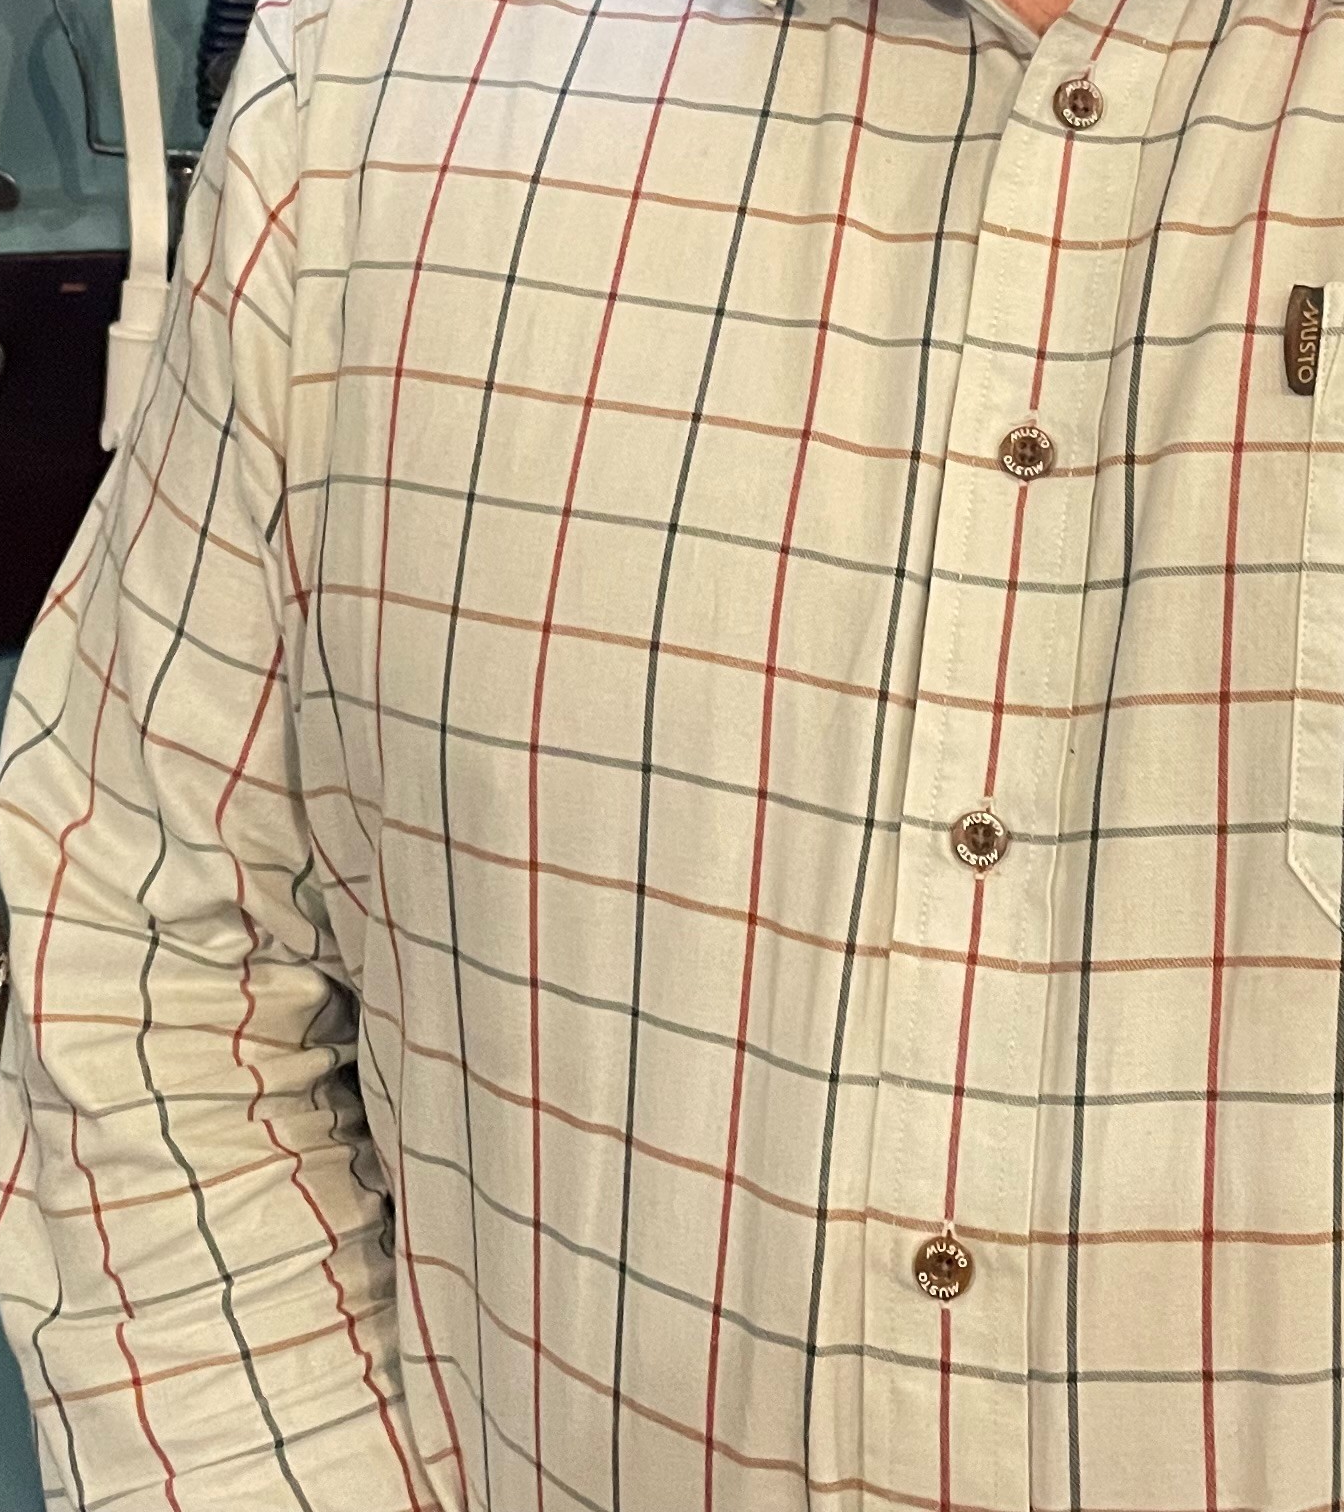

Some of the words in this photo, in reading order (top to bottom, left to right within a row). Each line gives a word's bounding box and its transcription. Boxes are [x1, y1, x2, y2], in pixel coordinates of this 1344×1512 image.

[1066, 80, 1100, 99] MUSTO
[1062, 108, 1098, 127] MUSTO
[1297, 298, 1319, 384] MUSTO
[1010, 427, 1050, 449] MUSTO
[1003, 454, 1044, 476] MUSTO
[962, 812, 1004, 837] MUSTO
[957, 843, 999, 867] MUSTO
[926, 1241, 968, 1268] MUSTO
[918, 1271, 959, 1299] MUSTO
